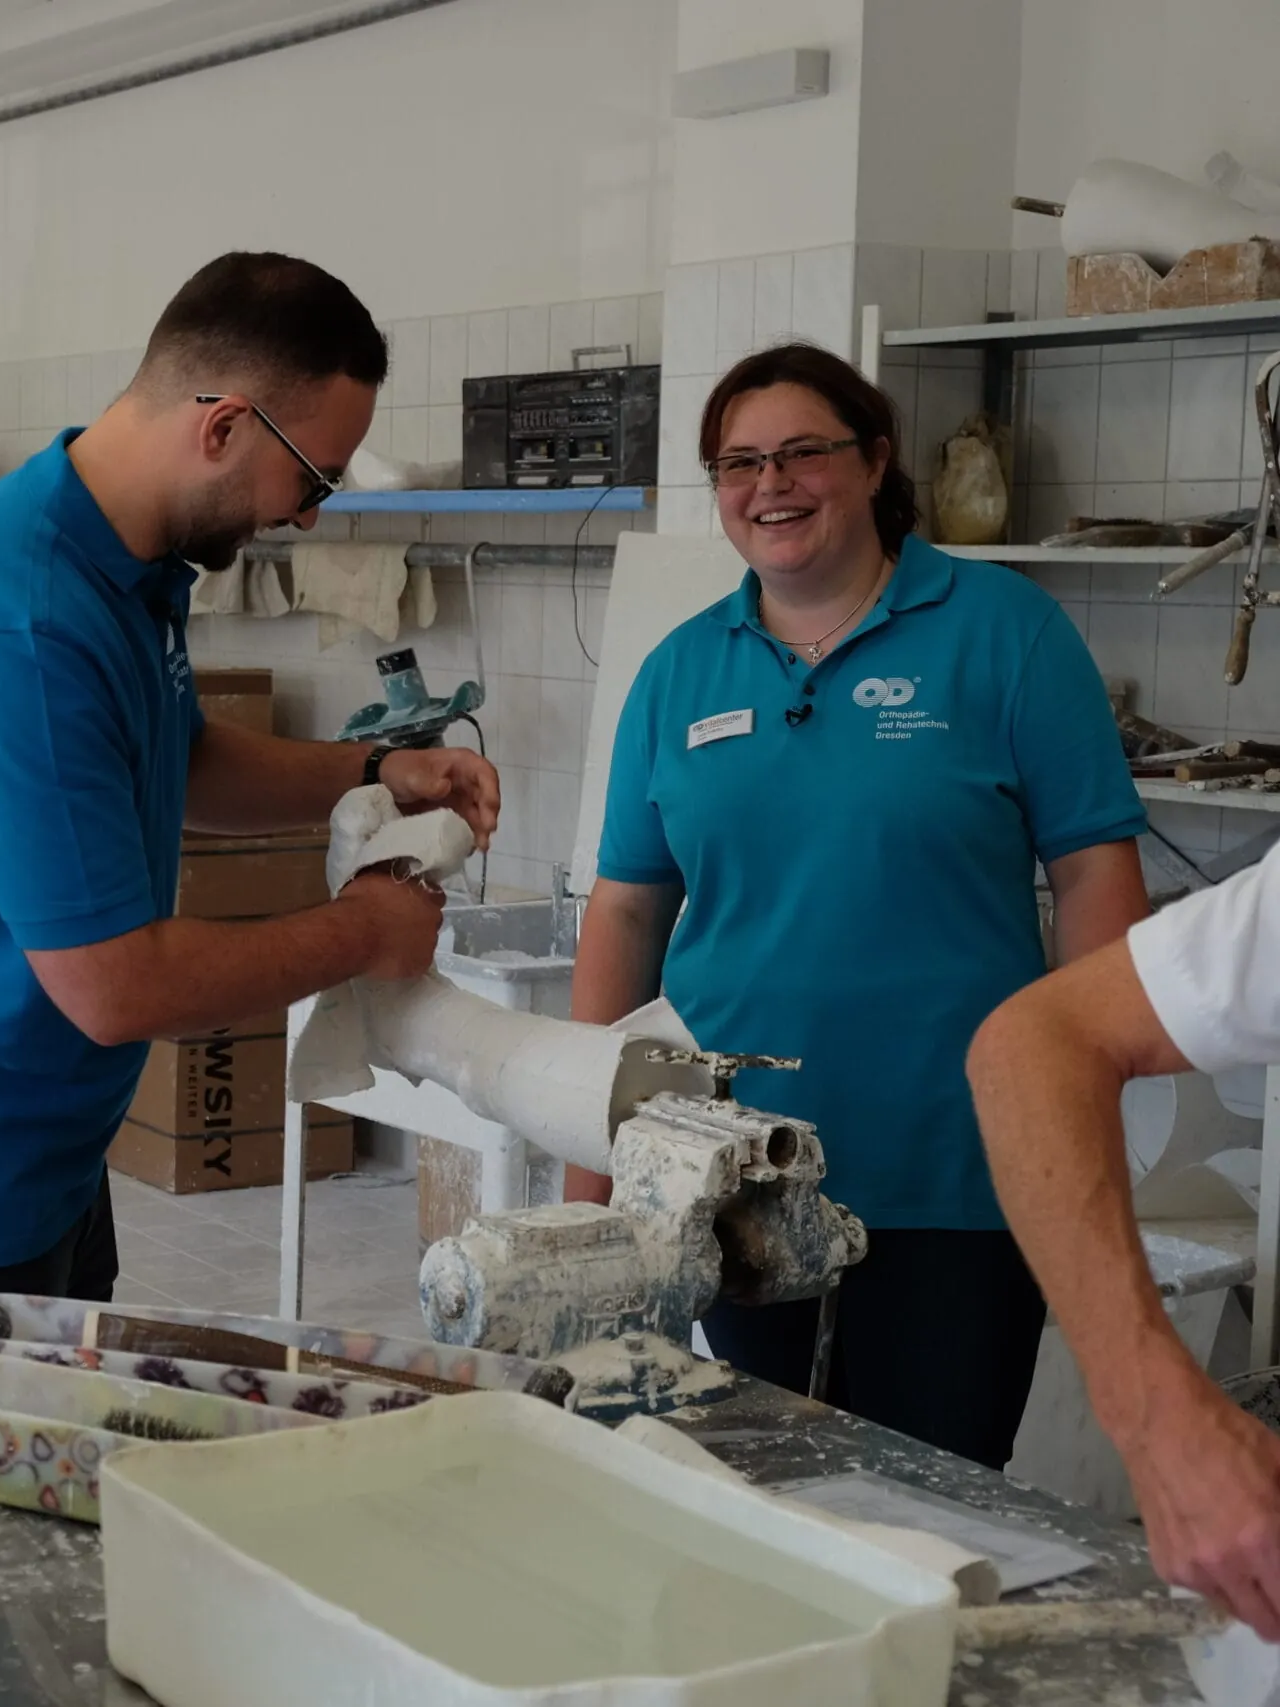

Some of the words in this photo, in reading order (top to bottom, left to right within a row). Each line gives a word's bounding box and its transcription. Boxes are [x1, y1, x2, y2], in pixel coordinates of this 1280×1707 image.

[879, 710, 930, 720] Orthopädie-
[877, 721, 894, 730] und
[895, 719, 950, 731] Rehatechnik
[875, 731, 912, 740] Dresden
[187, 1064, 198, 1118] WEITER
[204, 1028, 234, 1177] WSIKY
